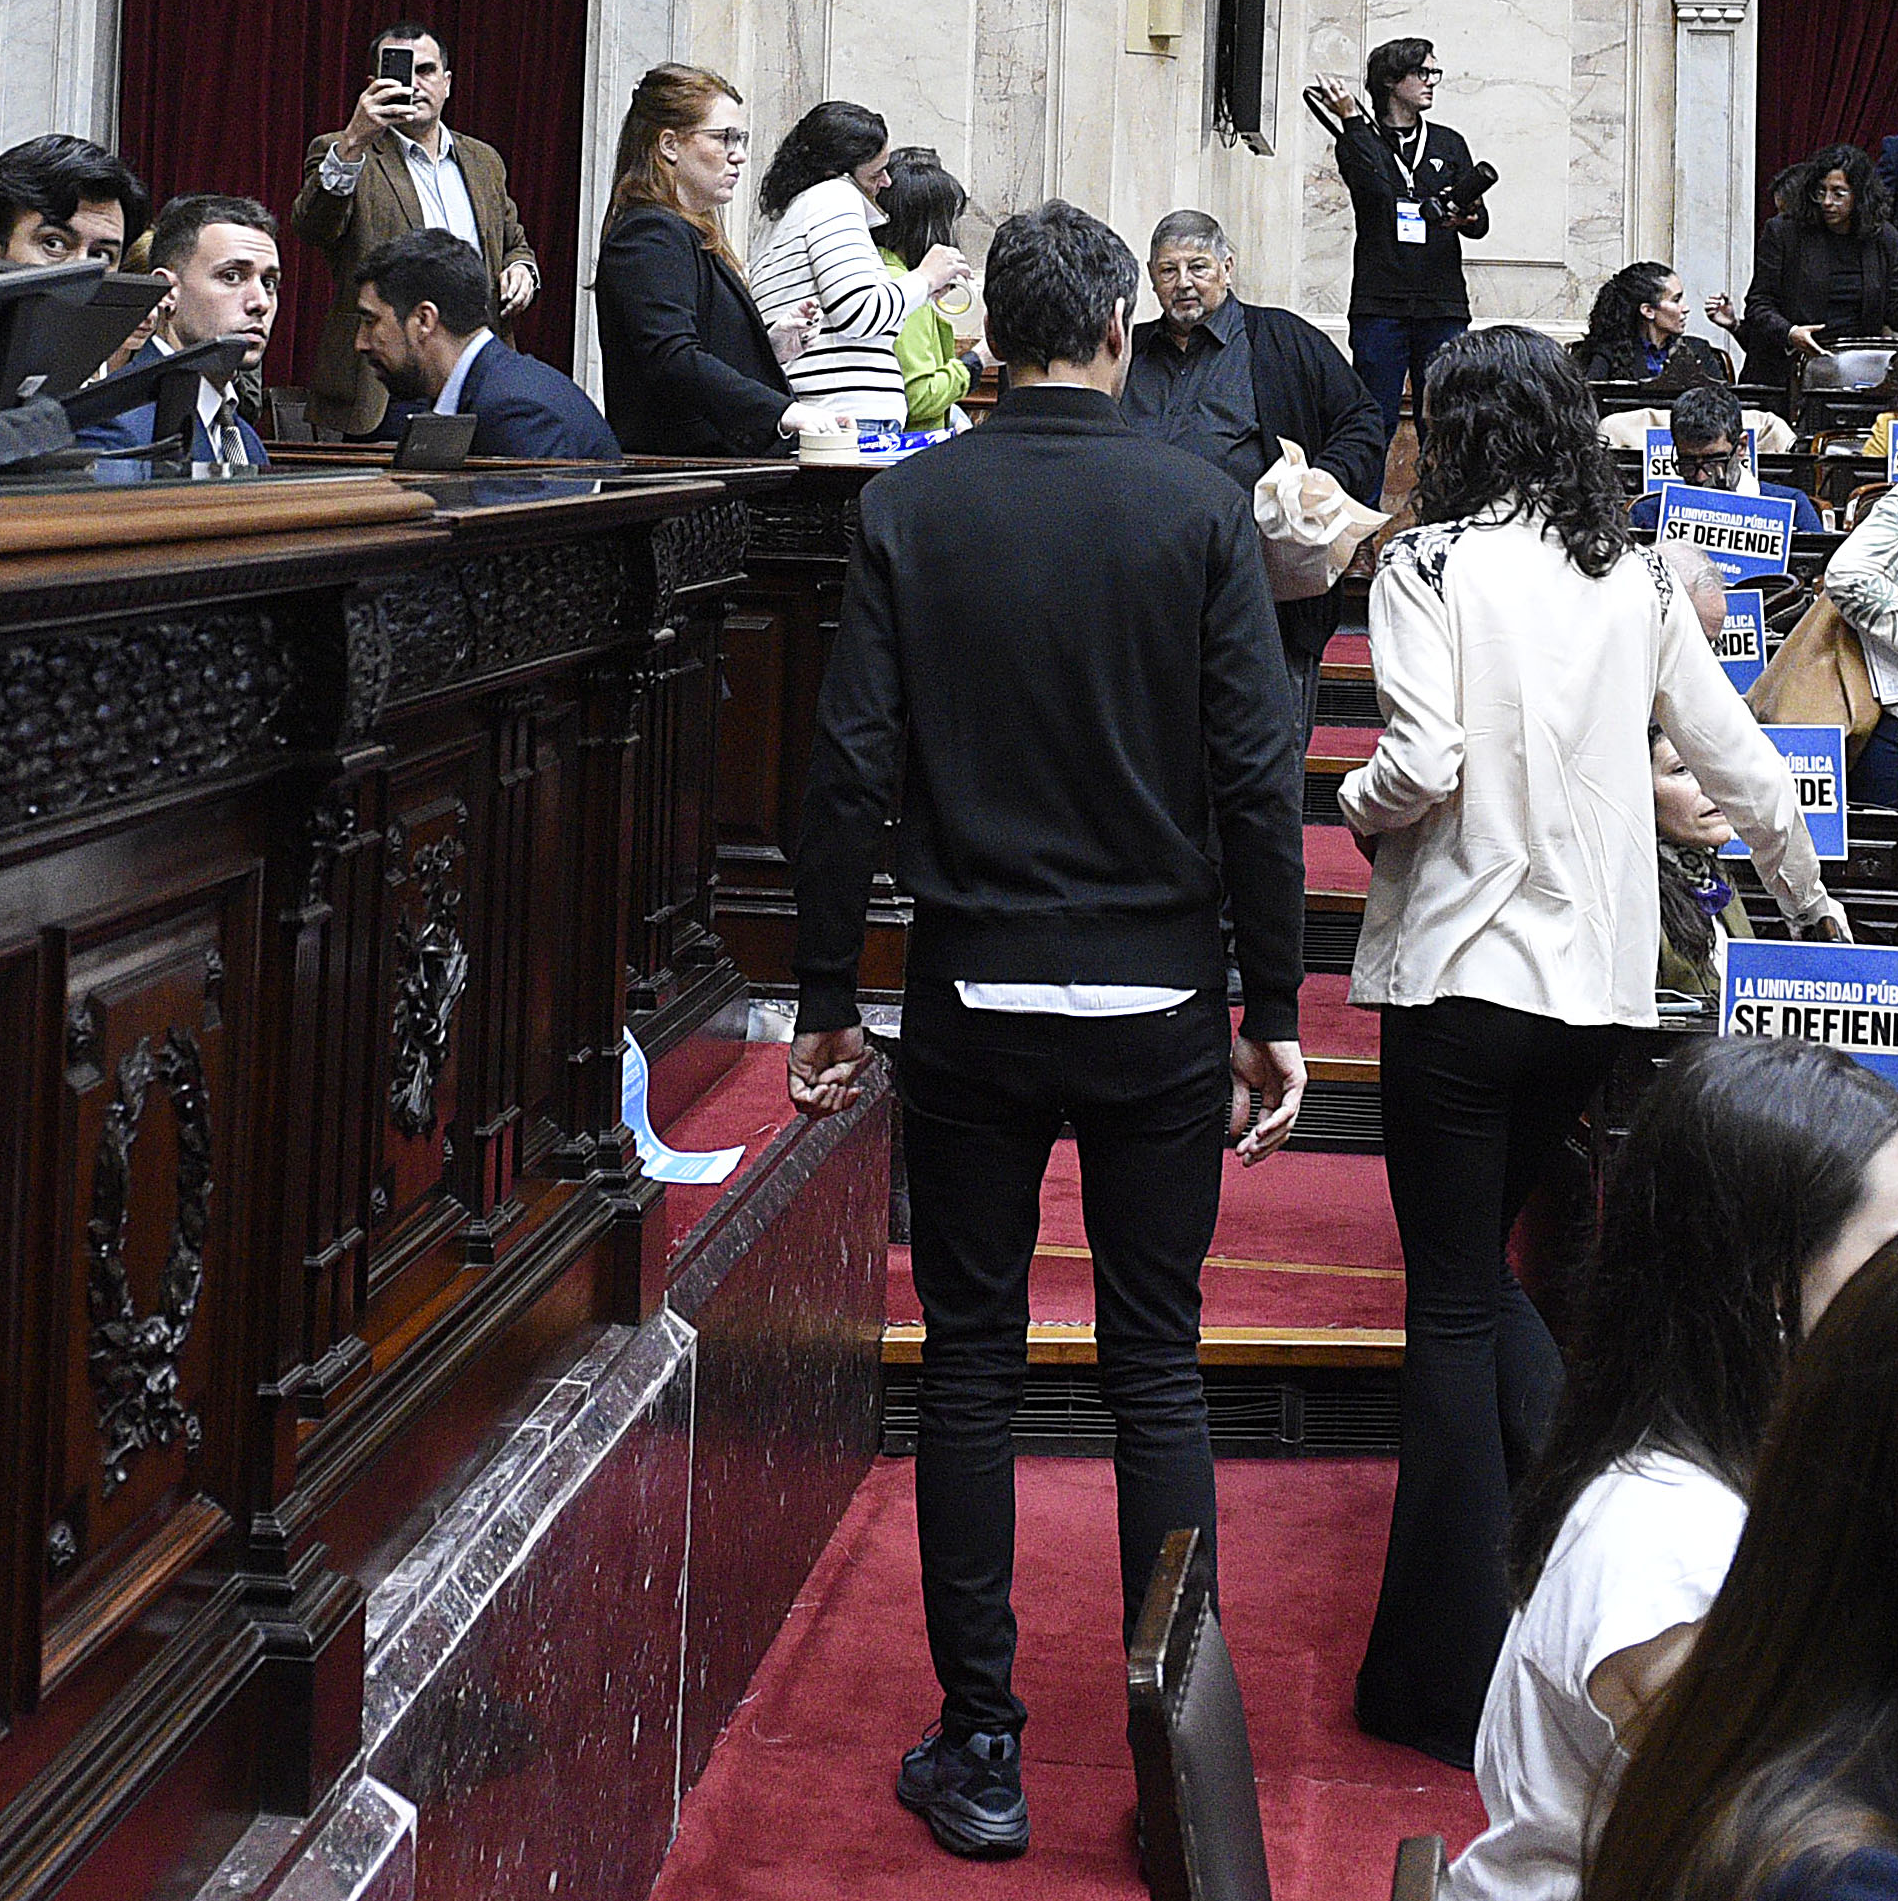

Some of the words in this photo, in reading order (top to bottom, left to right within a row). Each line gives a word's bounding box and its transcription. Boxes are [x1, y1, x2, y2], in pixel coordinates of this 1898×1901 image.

[1652, 459, 1671, 476] SE
[1668, 504, 1680, 518] LA
[1743, 514, 1783, 532] PÚBLICA
[1693, 524, 1782, 555] DEFIENDE
[1723, 614, 1755, 629] BLICA
[1735, 977, 1755, 998] LA
[1757, 978, 1862, 1002] UNIVERSIDAD
[1734, 1004, 1773, 1038] SE
